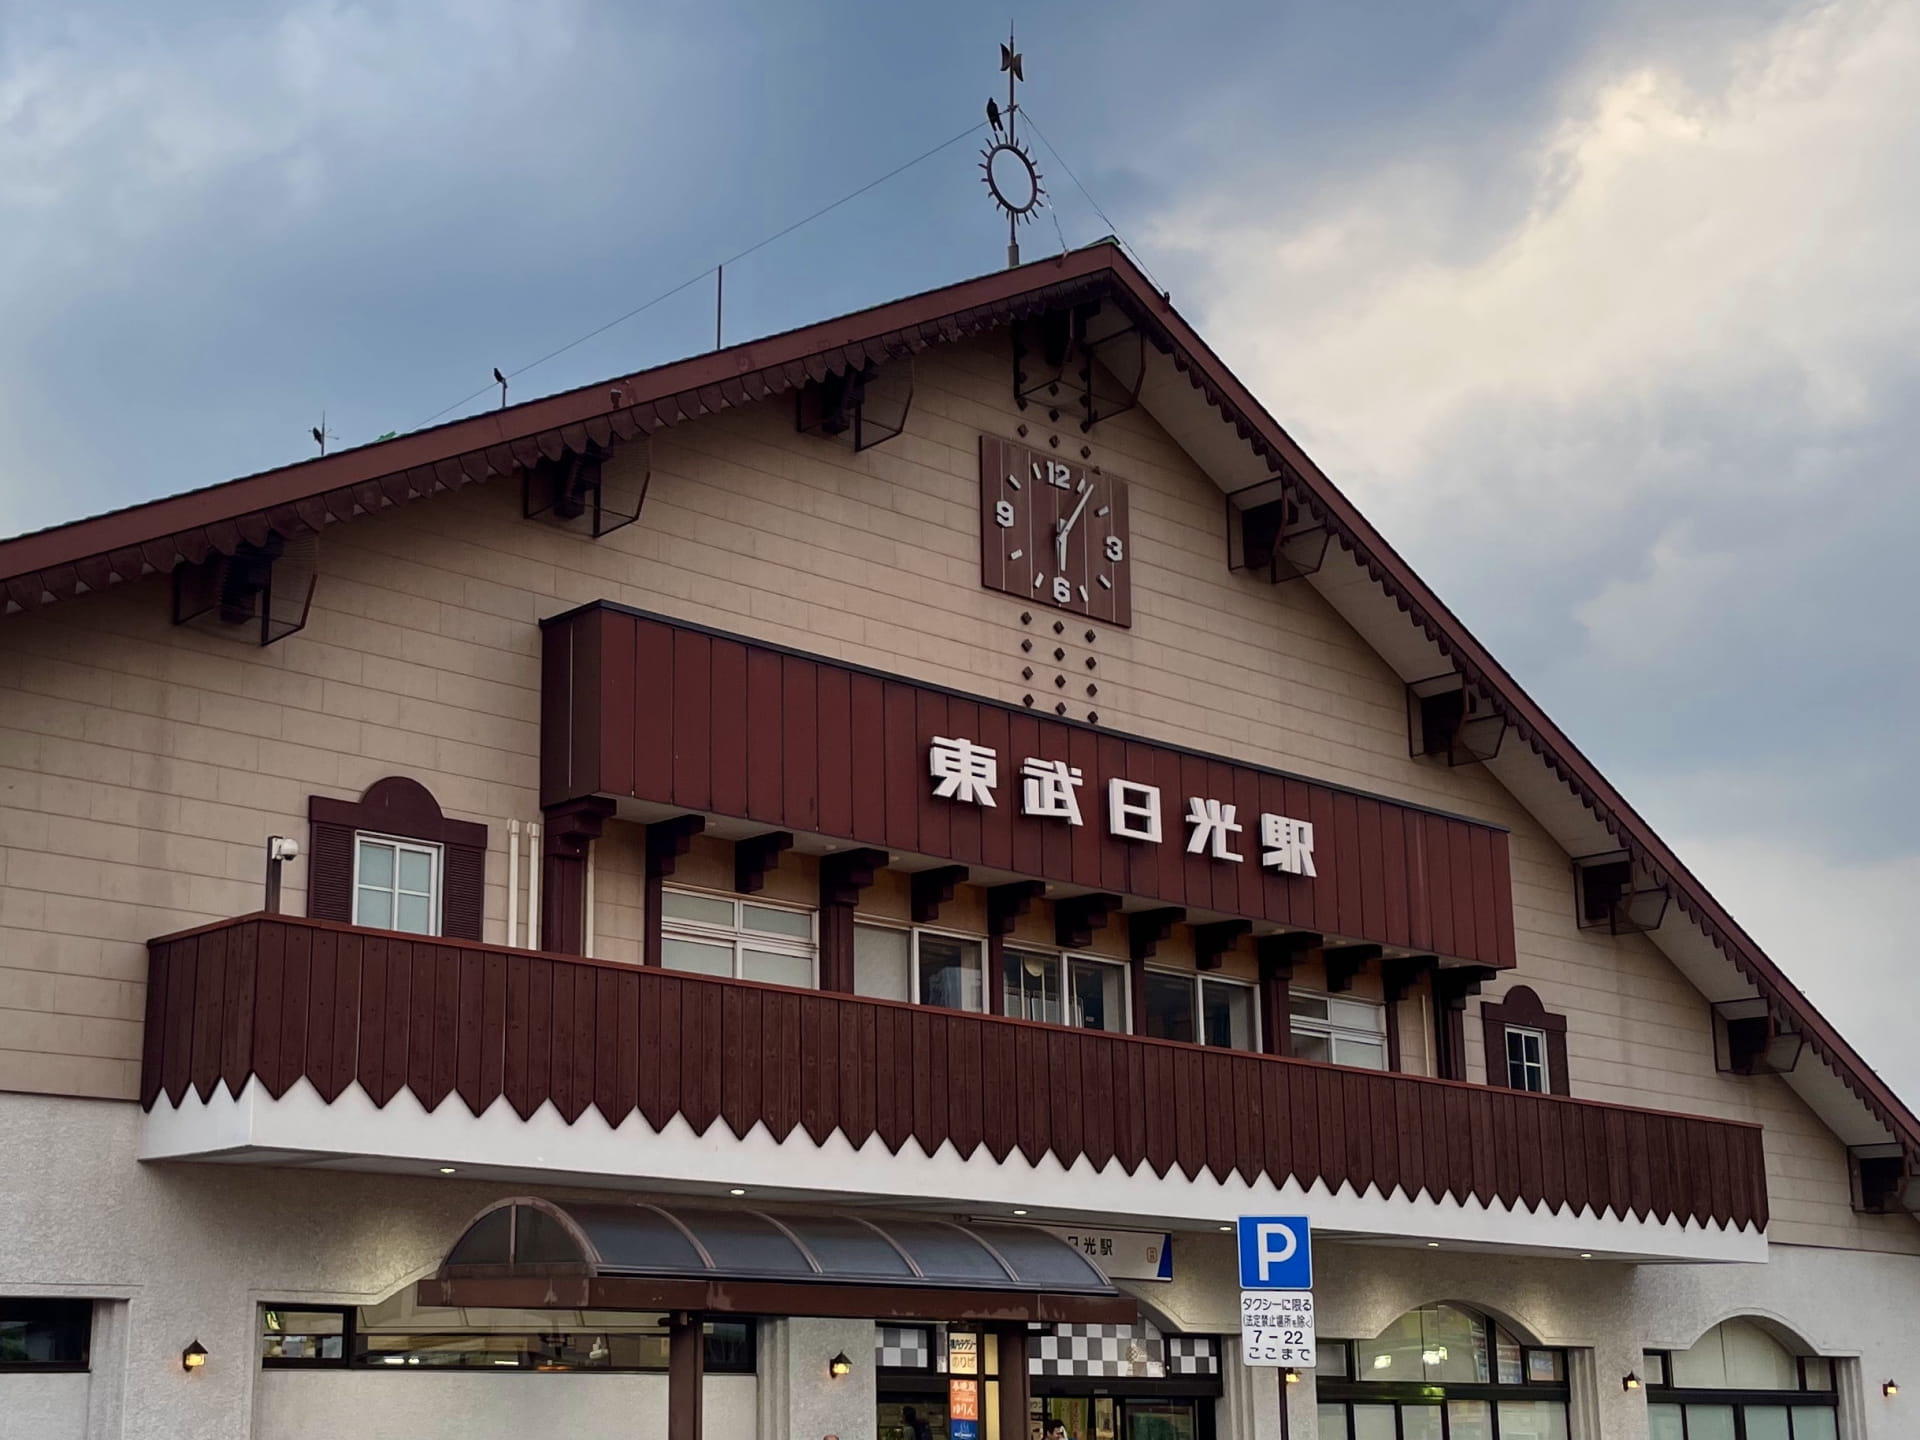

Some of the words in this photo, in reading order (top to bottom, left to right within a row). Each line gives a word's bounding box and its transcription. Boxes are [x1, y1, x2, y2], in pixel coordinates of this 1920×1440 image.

[1046, 461, 1070, 489] 12
[996, 500, 1014, 527] 9
[1106, 535, 1123, 561] 3
[1053, 576, 1070, 603] 6
[929, 735, 1317, 878] 東武日光駅
[1256, 1223, 1297, 1281] P
[1243, 1298, 1312, 1311] タクシーに限る
[1248, 1346, 1311, 1361] ここまで
